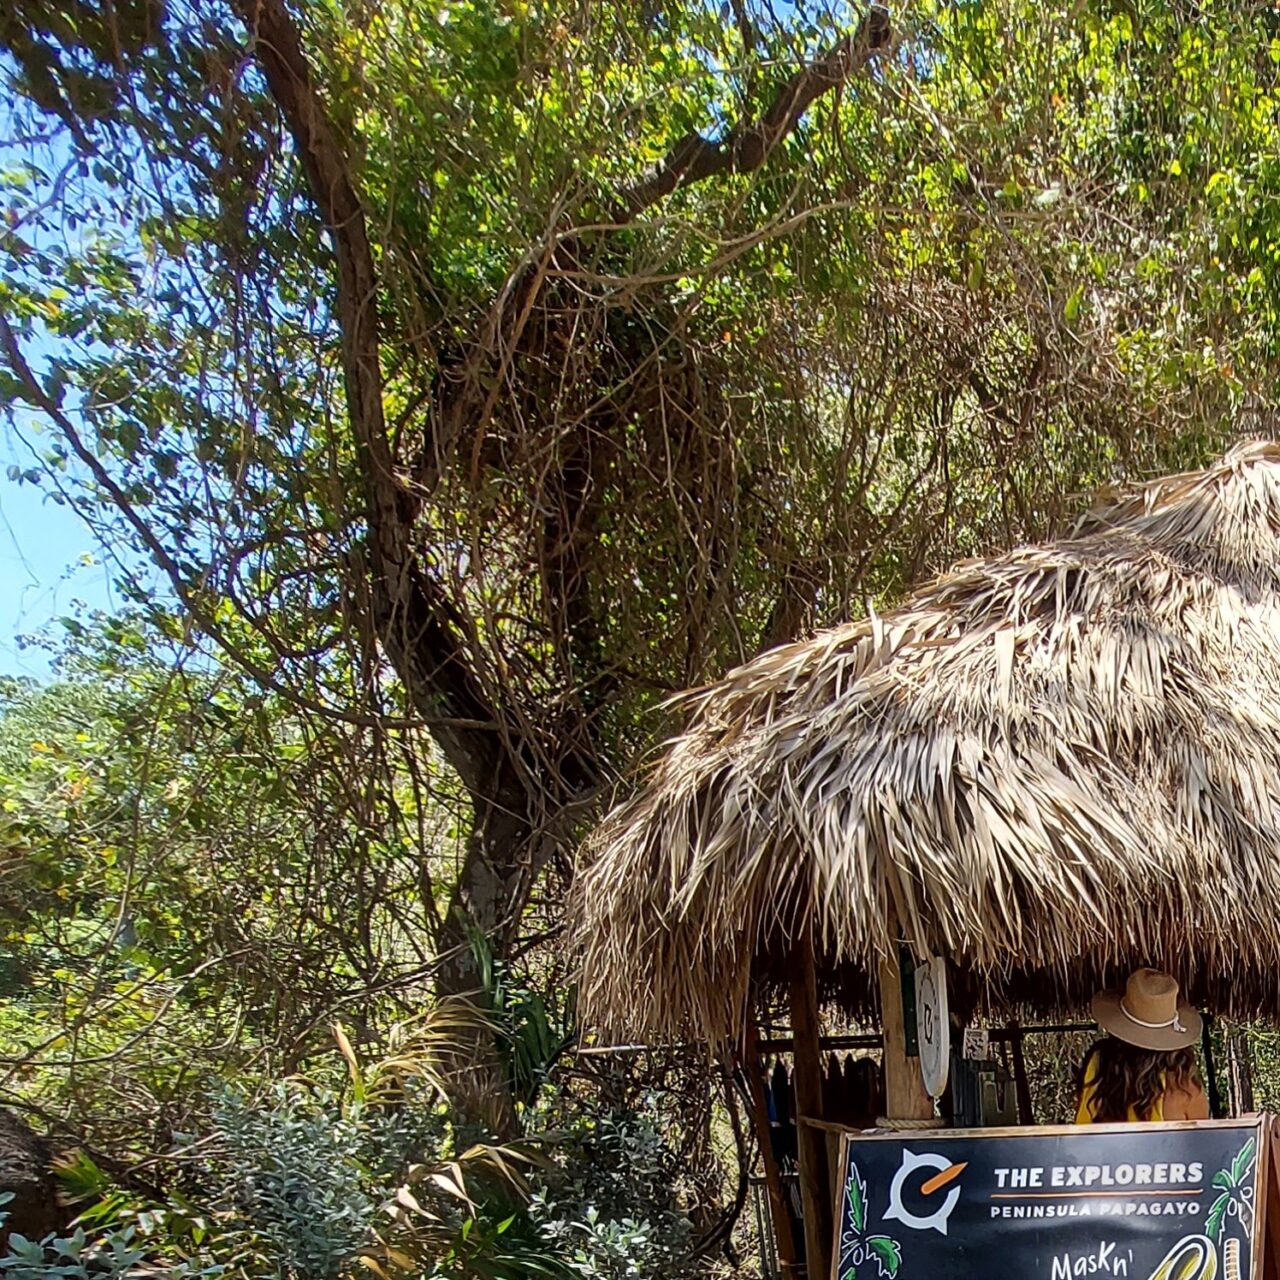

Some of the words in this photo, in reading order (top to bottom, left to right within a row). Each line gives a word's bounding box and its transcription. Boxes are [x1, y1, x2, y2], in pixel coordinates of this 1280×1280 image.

[994, 1167, 1043, 1188] THE
[1051, 1162, 1203, 1187] EXPLORERS
[990, 1204, 1091, 1218] PENINSULA
[1100, 1201, 1200, 1216] PAPAGAYO
